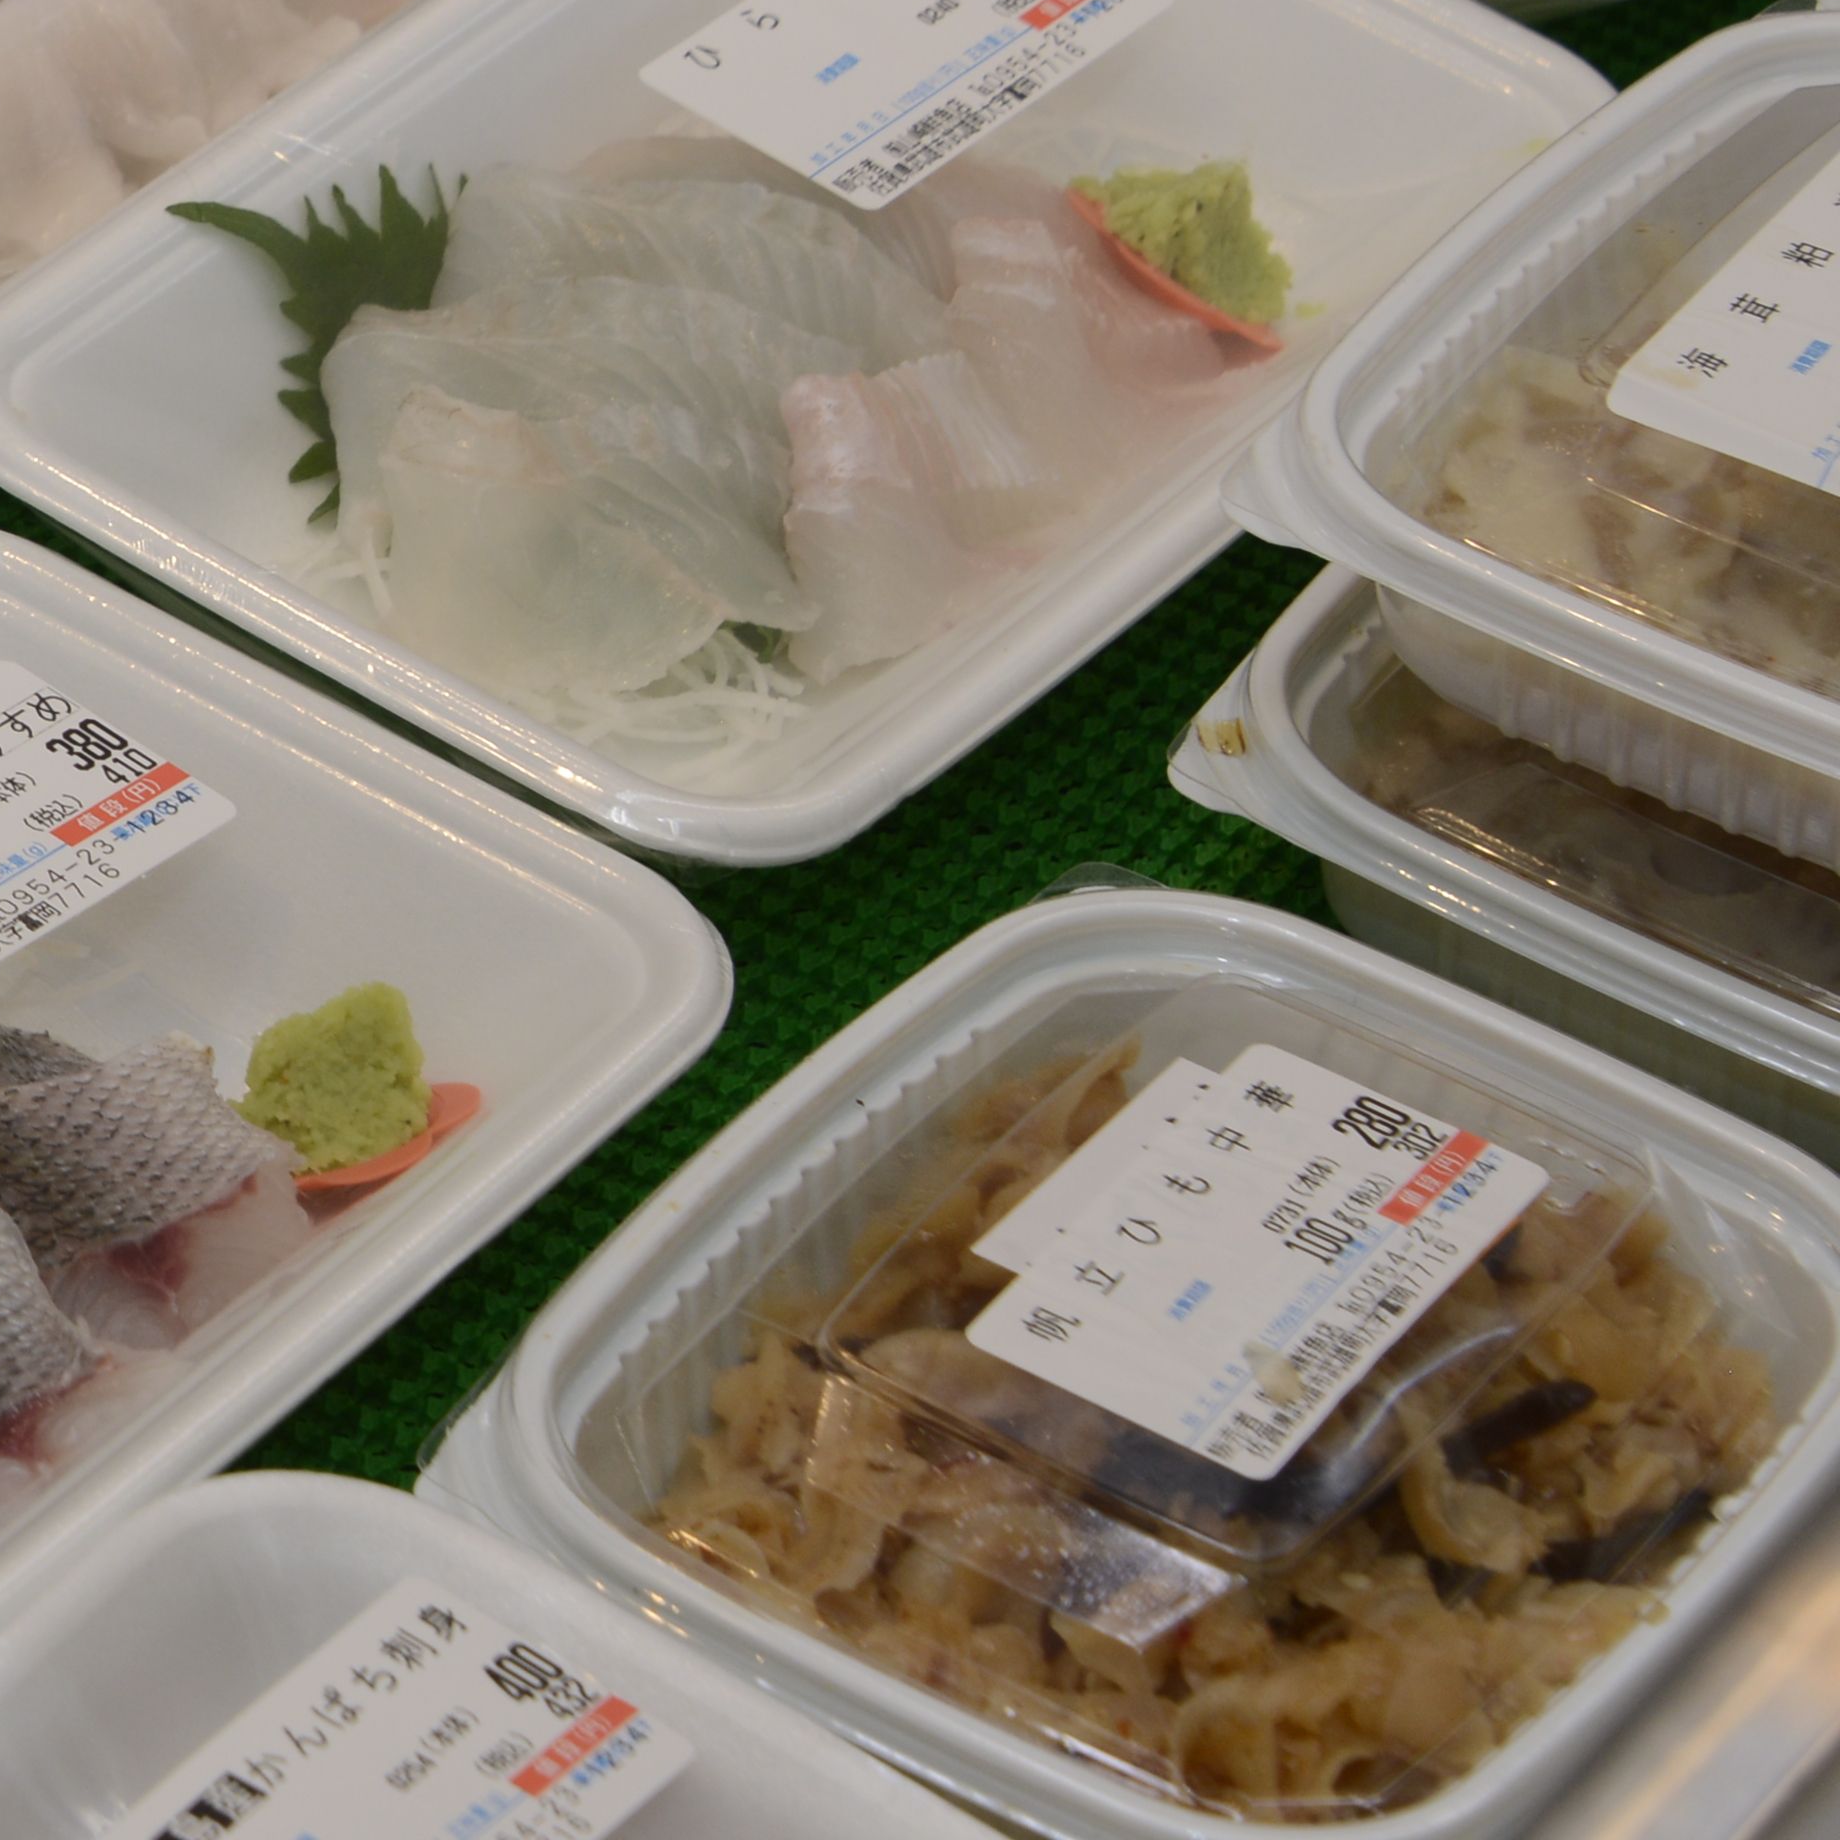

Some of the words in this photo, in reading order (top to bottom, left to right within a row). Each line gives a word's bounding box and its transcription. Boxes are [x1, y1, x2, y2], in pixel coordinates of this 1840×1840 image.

[1677, 192, 1840, 378] 海茸粕
[45, 718, 129, 771] 380
[23, 793, 84, 832] (税込)
[102, 747, 158, 784] 410
[73, 776, 166, 835] 値段(円)
[1332, 1095, 1412, 1150] 280
[1392, 1122, 1448, 1161] 302
[1022, 1081, 1293, 1341] 帆立ひも中華
[245, 1604, 469, 1790] かんぱち刺身
[483, 1642, 564, 1701] 400
[543, 1678, 599, 1720] 432
